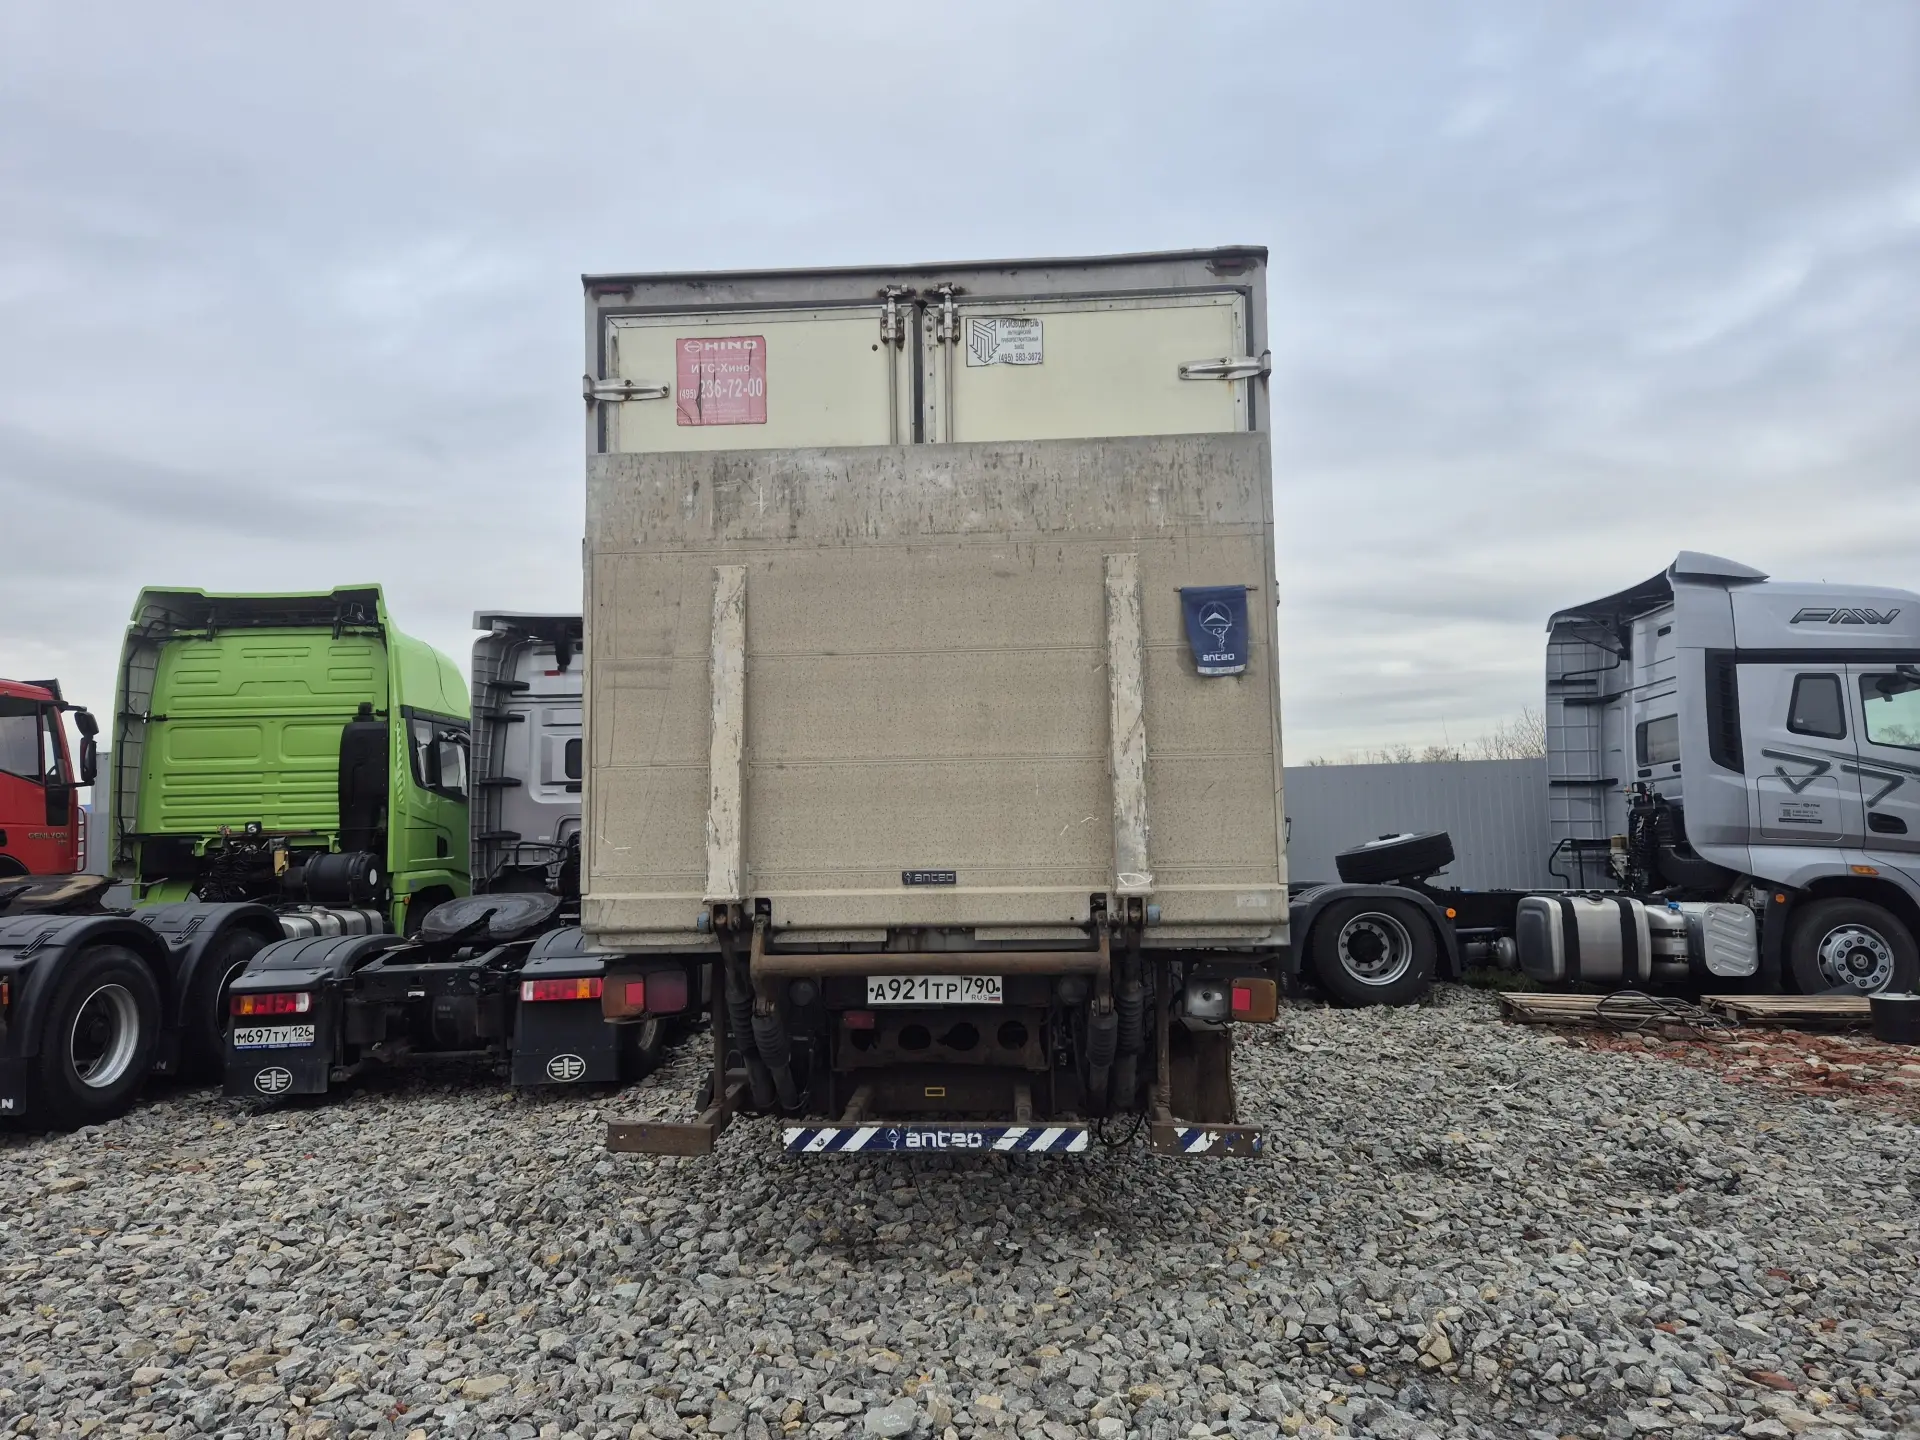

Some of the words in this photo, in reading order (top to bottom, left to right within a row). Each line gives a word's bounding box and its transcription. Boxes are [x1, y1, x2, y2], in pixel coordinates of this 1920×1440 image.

[704, 340, 758, 351] HINO
[999, 353, 1014, 363] (495)
[691, 363, 750, 374] ИТС-Хино
[679, 388, 697, 401] (495)
[700, 378, 763, 398] 236-72-00
[1789, 607, 1901, 625] FAW
[1202, 653, 1235, 662] anteo
[914, 873, 954, 882] anteo
[963, 977, 996, 994] 790
[291, 1026, 311, 1038] 126
[0, 1098, 14, 1110] N
[905, 1130, 983, 1148] anteo
